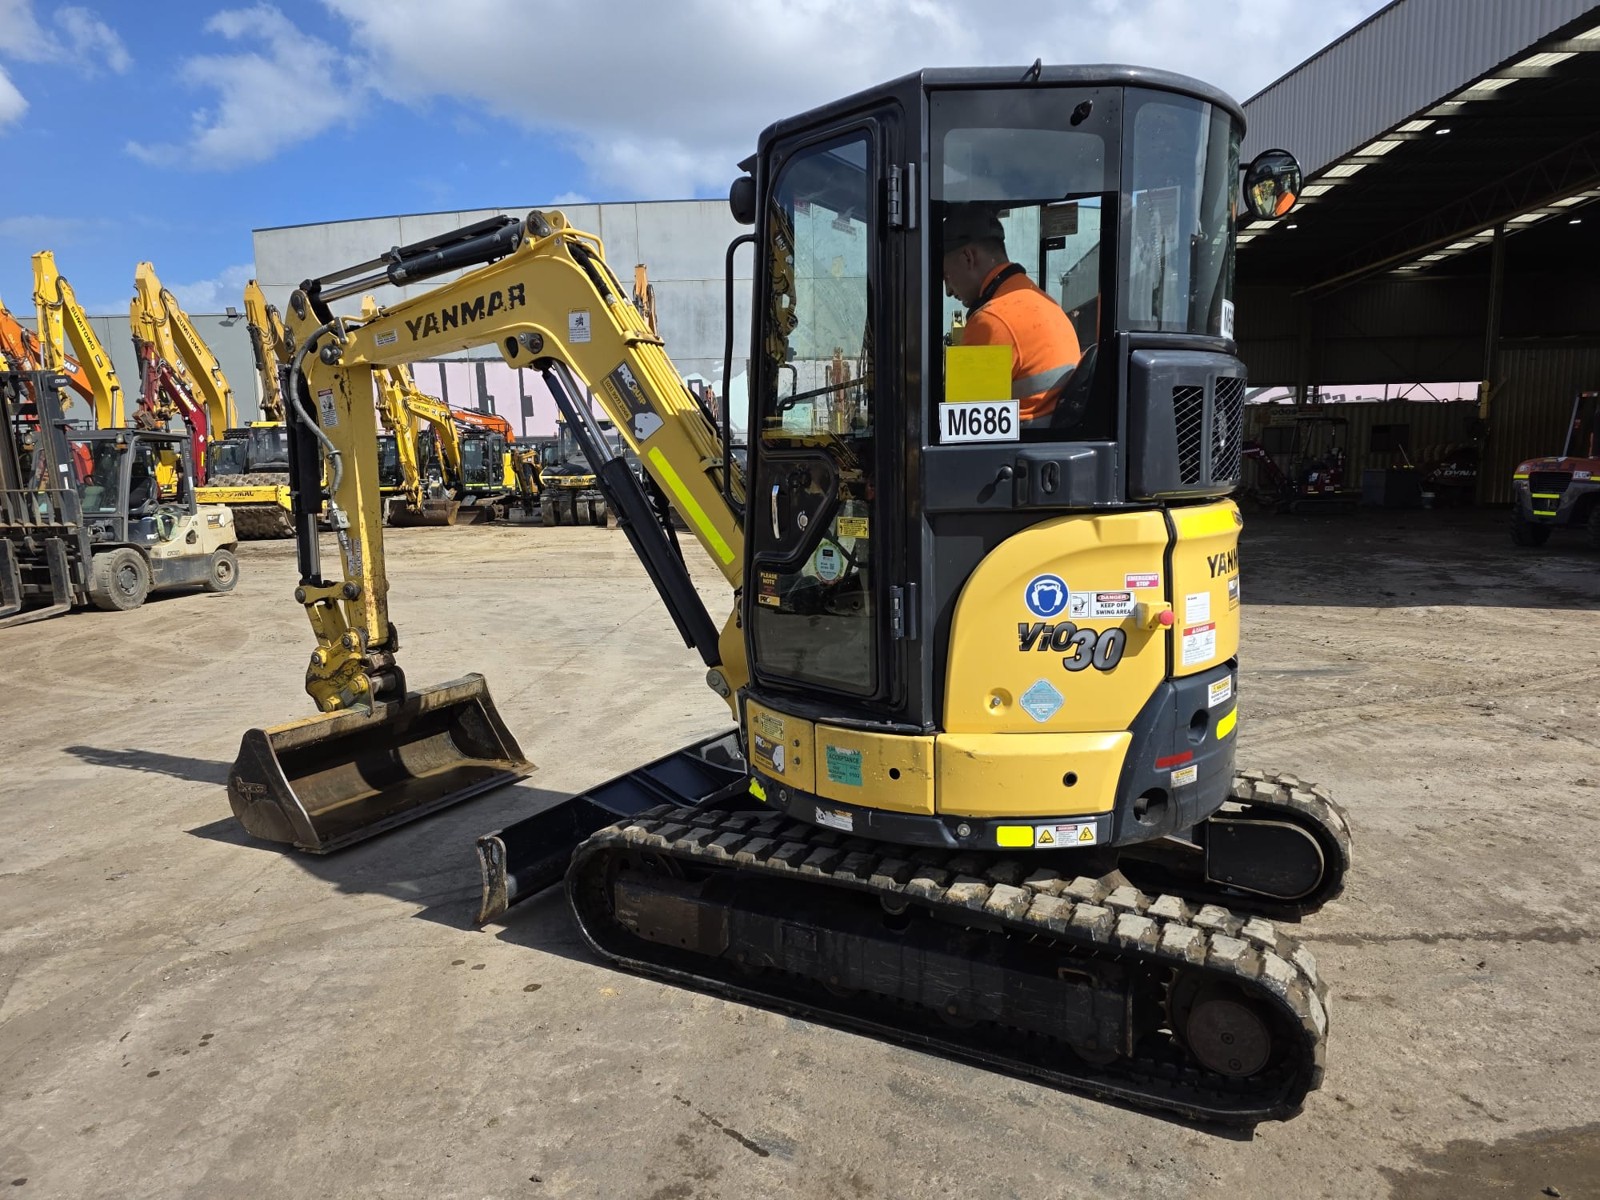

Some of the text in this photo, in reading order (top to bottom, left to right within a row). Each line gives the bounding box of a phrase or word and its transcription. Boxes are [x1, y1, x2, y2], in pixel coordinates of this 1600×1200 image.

[70, 306, 96, 351] SUMITOMO
[405, 282, 526, 342] YANMAR
[176, 315, 202, 356] SUMITOMO
[947, 406, 1012, 436] M686
[760, 572, 778, 580] PLEASE
